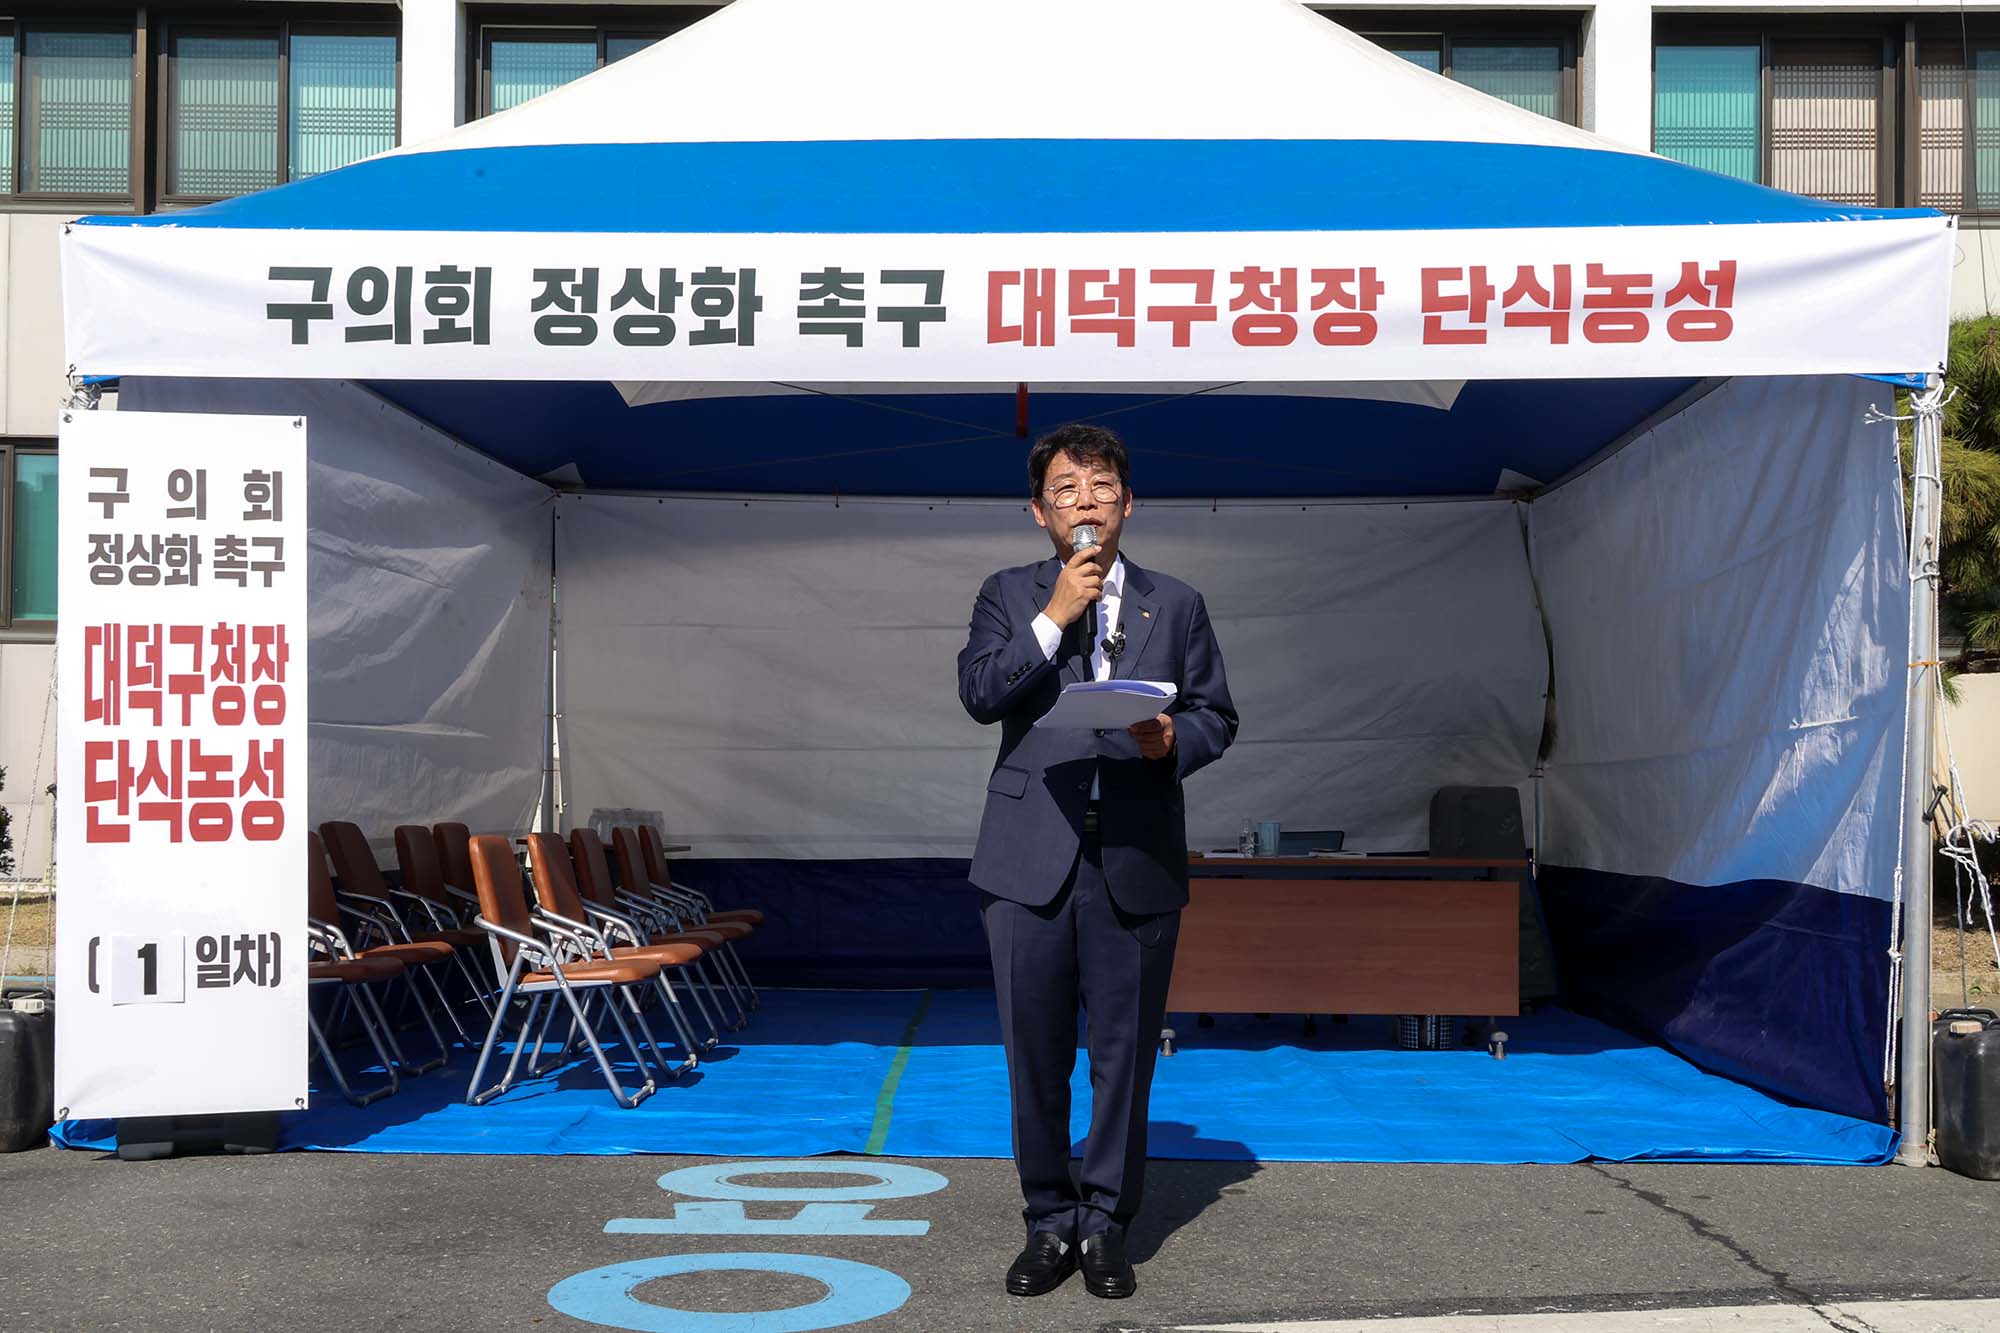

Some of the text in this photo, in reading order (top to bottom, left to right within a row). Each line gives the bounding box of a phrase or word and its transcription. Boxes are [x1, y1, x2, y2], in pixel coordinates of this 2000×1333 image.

[266, 259, 1737, 348] 구의회 정상화 촉구 대덕구청장 단식농성
[87, 533, 286, 588] 정상화 촉구
[84, 622, 289, 727] 대덕구청장
[84, 738, 285, 843] 단식농성
